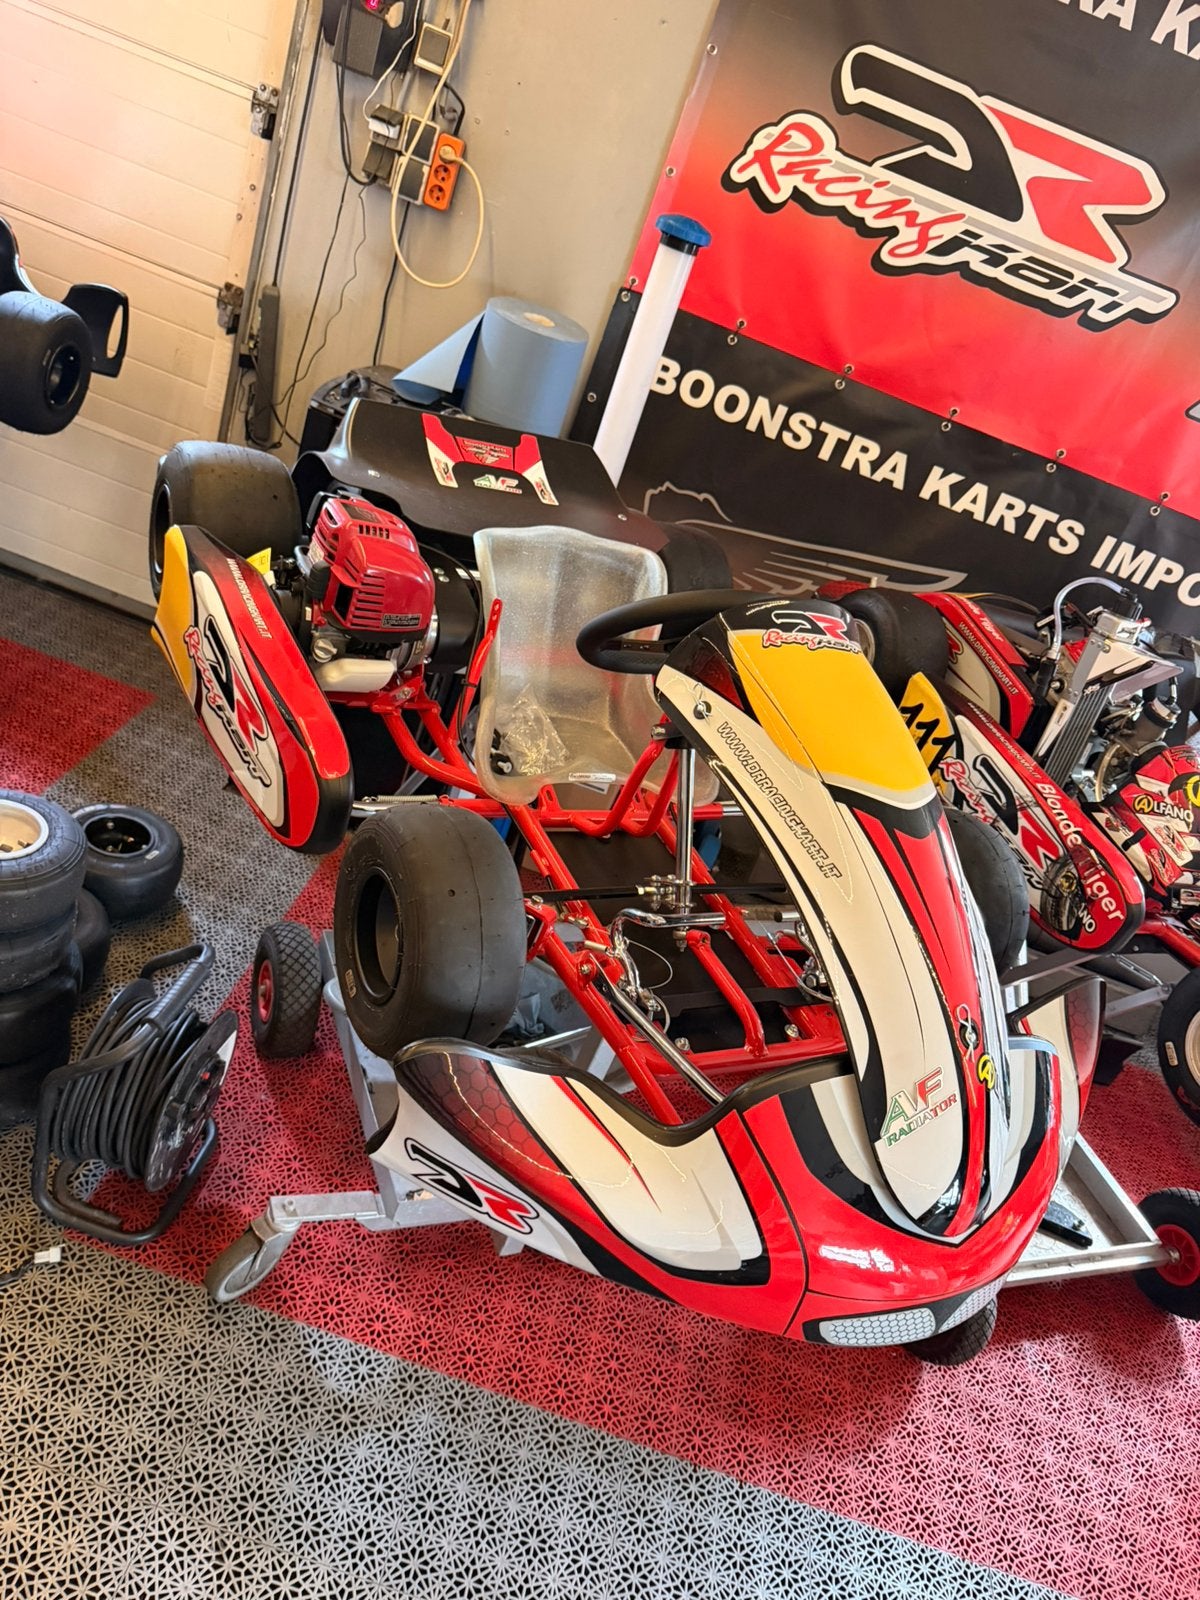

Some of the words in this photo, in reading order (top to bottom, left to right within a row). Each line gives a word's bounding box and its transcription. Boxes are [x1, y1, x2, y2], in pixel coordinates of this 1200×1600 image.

[736, 121, 967, 258] Racing
[649, 355, 909, 491] BOONSTRA
[918, 464, 1086, 556] KARTS
[763, 630, 818, 649] Racing
[716, 721, 842, 882] WWW.DRRACINGKART.IT
[1036, 783, 1083, 848] Blonde
[1133, 794, 1194, 824] ALFANO
[886, 1092, 958, 1148] RADIATOR
